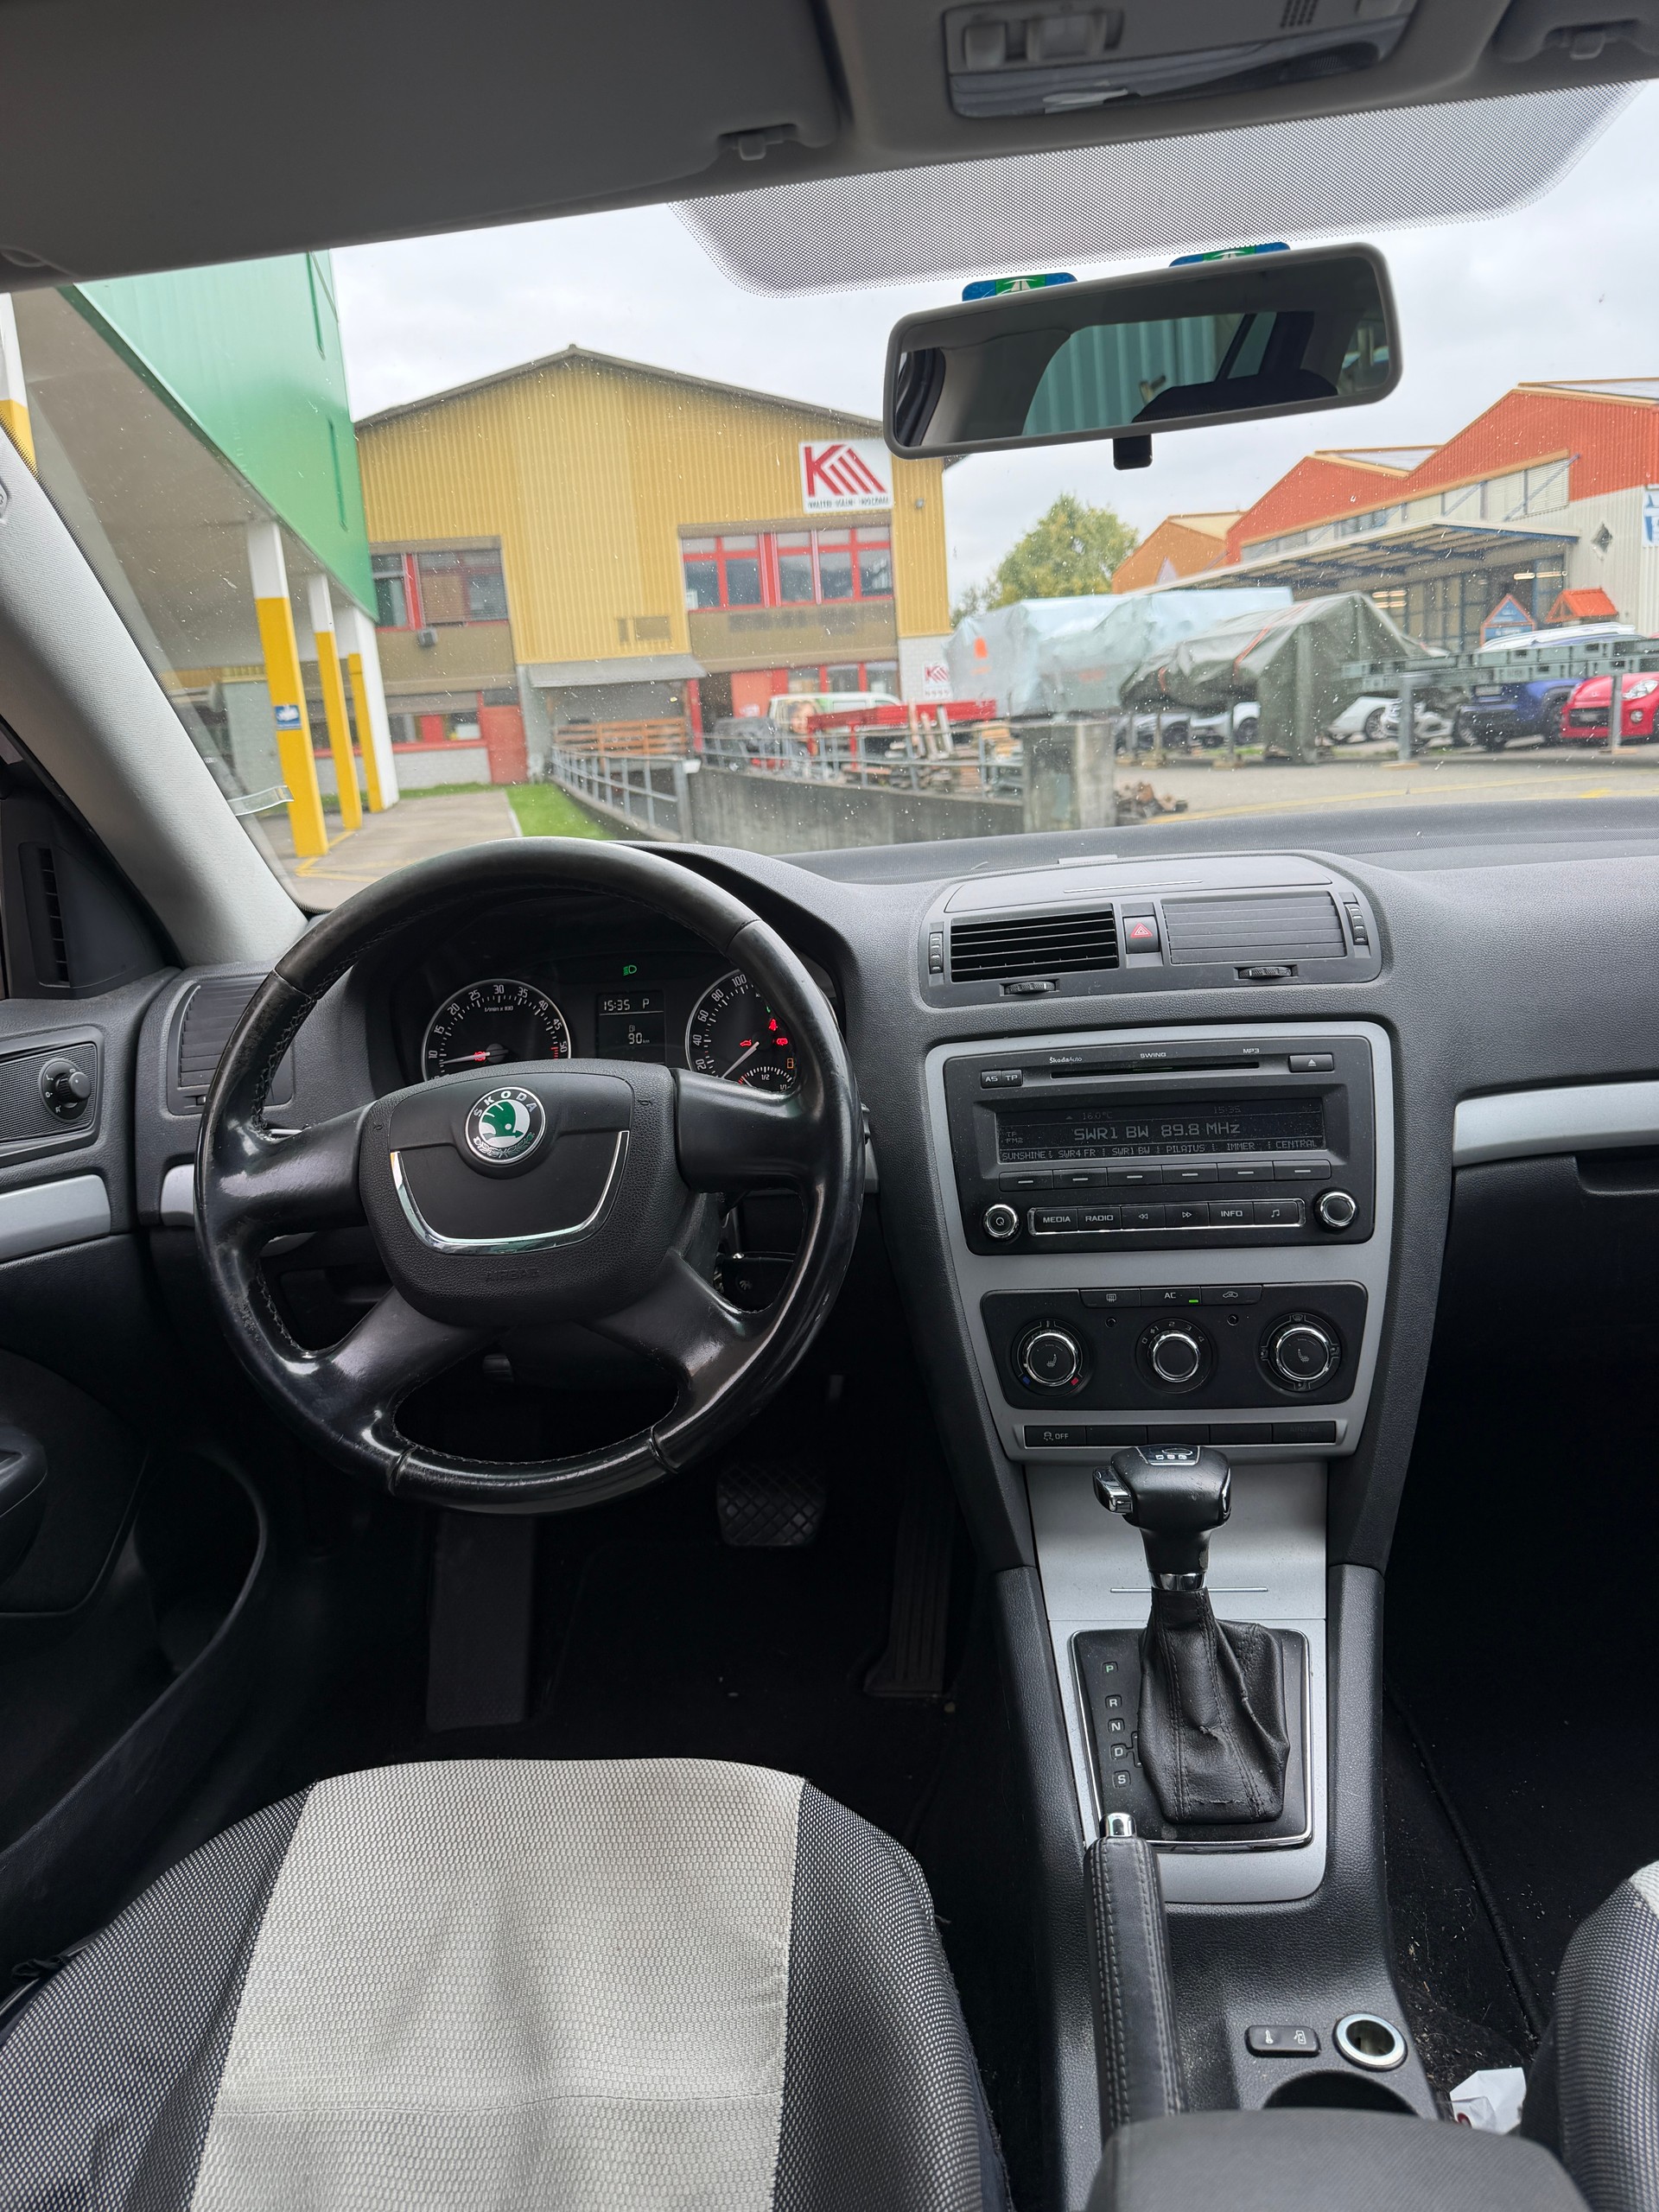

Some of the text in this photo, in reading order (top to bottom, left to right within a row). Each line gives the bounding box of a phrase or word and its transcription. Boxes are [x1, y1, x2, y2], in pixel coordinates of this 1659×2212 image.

[732, 974, 747, 988] 100
[468, 989, 481, 1001] 25
[493, 984, 505, 995] 30
[518, 986, 529, 999] 35
[711, 988, 724, 1001] 80
[447, 1002, 461, 1015] 20
[538, 1000, 549, 1011] 40
[604, 999, 631, 1011] 15:35
[643, 998, 650, 1009] P
[697, 1009, 709, 1022] 60
[434, 1025, 445, 1035] 15
[553, 1018, 563, 1031] 45
[628, 1033, 643, 1045] 90
[692, 1034, 702, 1046] 40
[559, 1040, 568, 1053] 50
[428, 1050, 438, 1059] 10
[695, 1058, 707, 1071] 20
[1074, 1122, 1241, 1141] SWR1 BW 89.8 MHz
[1166, 1144, 1205, 1154] PILATUS
[1226, 1141, 1255, 1152] IMMER
[1275, 1139, 1318, 1149] CENTRAL
[1001, 1150, 1046, 1160] SUNSHINE
[1058, 1148, 1096, 1159] SWR4 FR
[1111, 1146, 1150, 1156] SWR1 BW
[1085, 1214, 1114, 1223] RADIO
[1111, 1722, 1121, 1732] N
[1115, 1748, 1123, 1757] D
[1117, 1775, 1126, 1784] S
